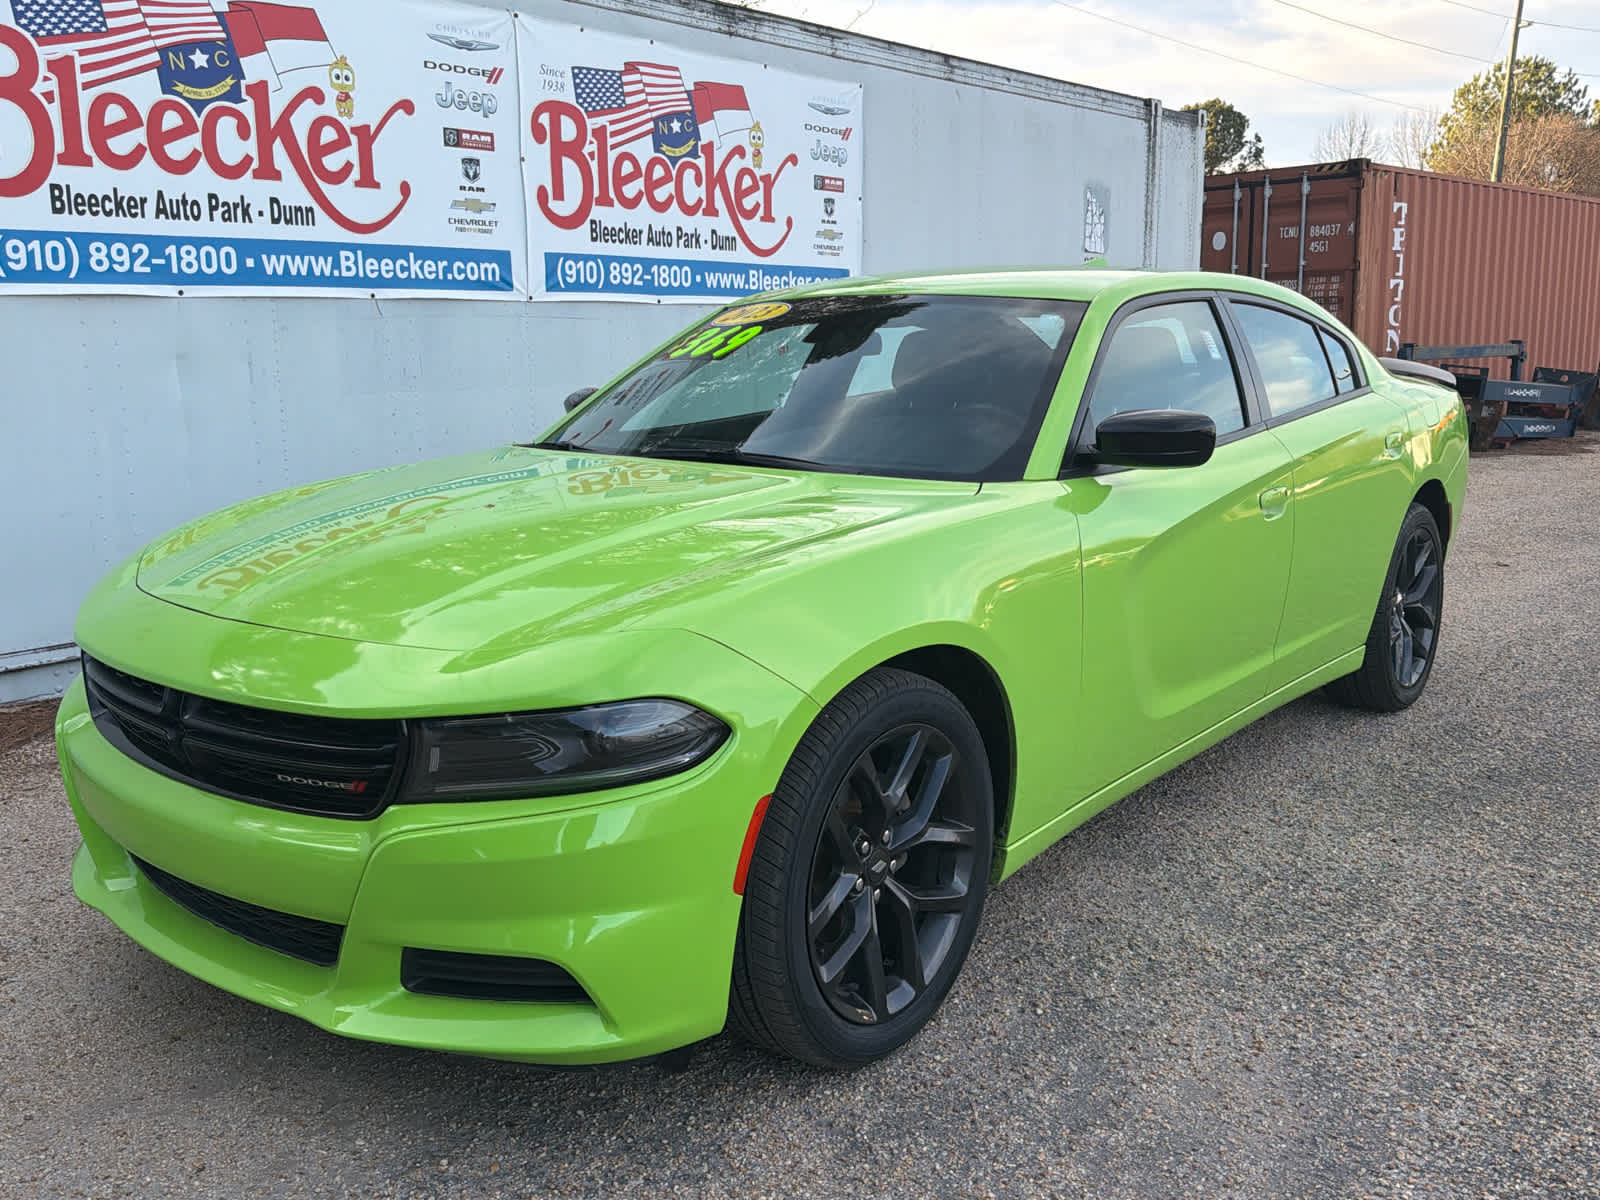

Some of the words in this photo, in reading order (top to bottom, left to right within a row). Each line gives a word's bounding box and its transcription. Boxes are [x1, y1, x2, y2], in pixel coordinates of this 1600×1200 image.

[168, 51, 186, 71] N
[424, 60, 493, 79] DODGE
[539, 63, 566, 79] Since
[541, 79, 566, 93] 1938
[434, 81, 498, 118] Jeep
[658, 121, 668, 135] N
[804, 123, 848, 137] DODGE
[461, 132, 492, 143] RAM
[810, 139, 848, 168] Jeep
[531, 100, 799, 257] Bleecker
[459, 185, 486, 193] RAM
[49, 183, 148, 219] Bleecker
[155, 189, 202, 222] Auto
[207, 192, 254, 224] Park
[269, 196, 316, 227] Dunn
[448, 217, 499, 228] CHEVROLET
[589, 218, 644, 246] Bleecker
[646, 223, 673, 248] Auto
[676, 226, 702, 250] Park
[710, 229, 737, 252] Dunn
[1280, 226, 1299, 239] TCNU
[1309, 223, 1341, 238] 884037
[1309, 241, 1329, 253] 45G1
[89, 240, 238, 277] 892-1800
[261, 249, 501, 283] www.Bleecker.com
[556, 256, 606, 289] (910)
[610, 261, 692, 288] 892-1800
[277, 774, 354, 790] DODGE
